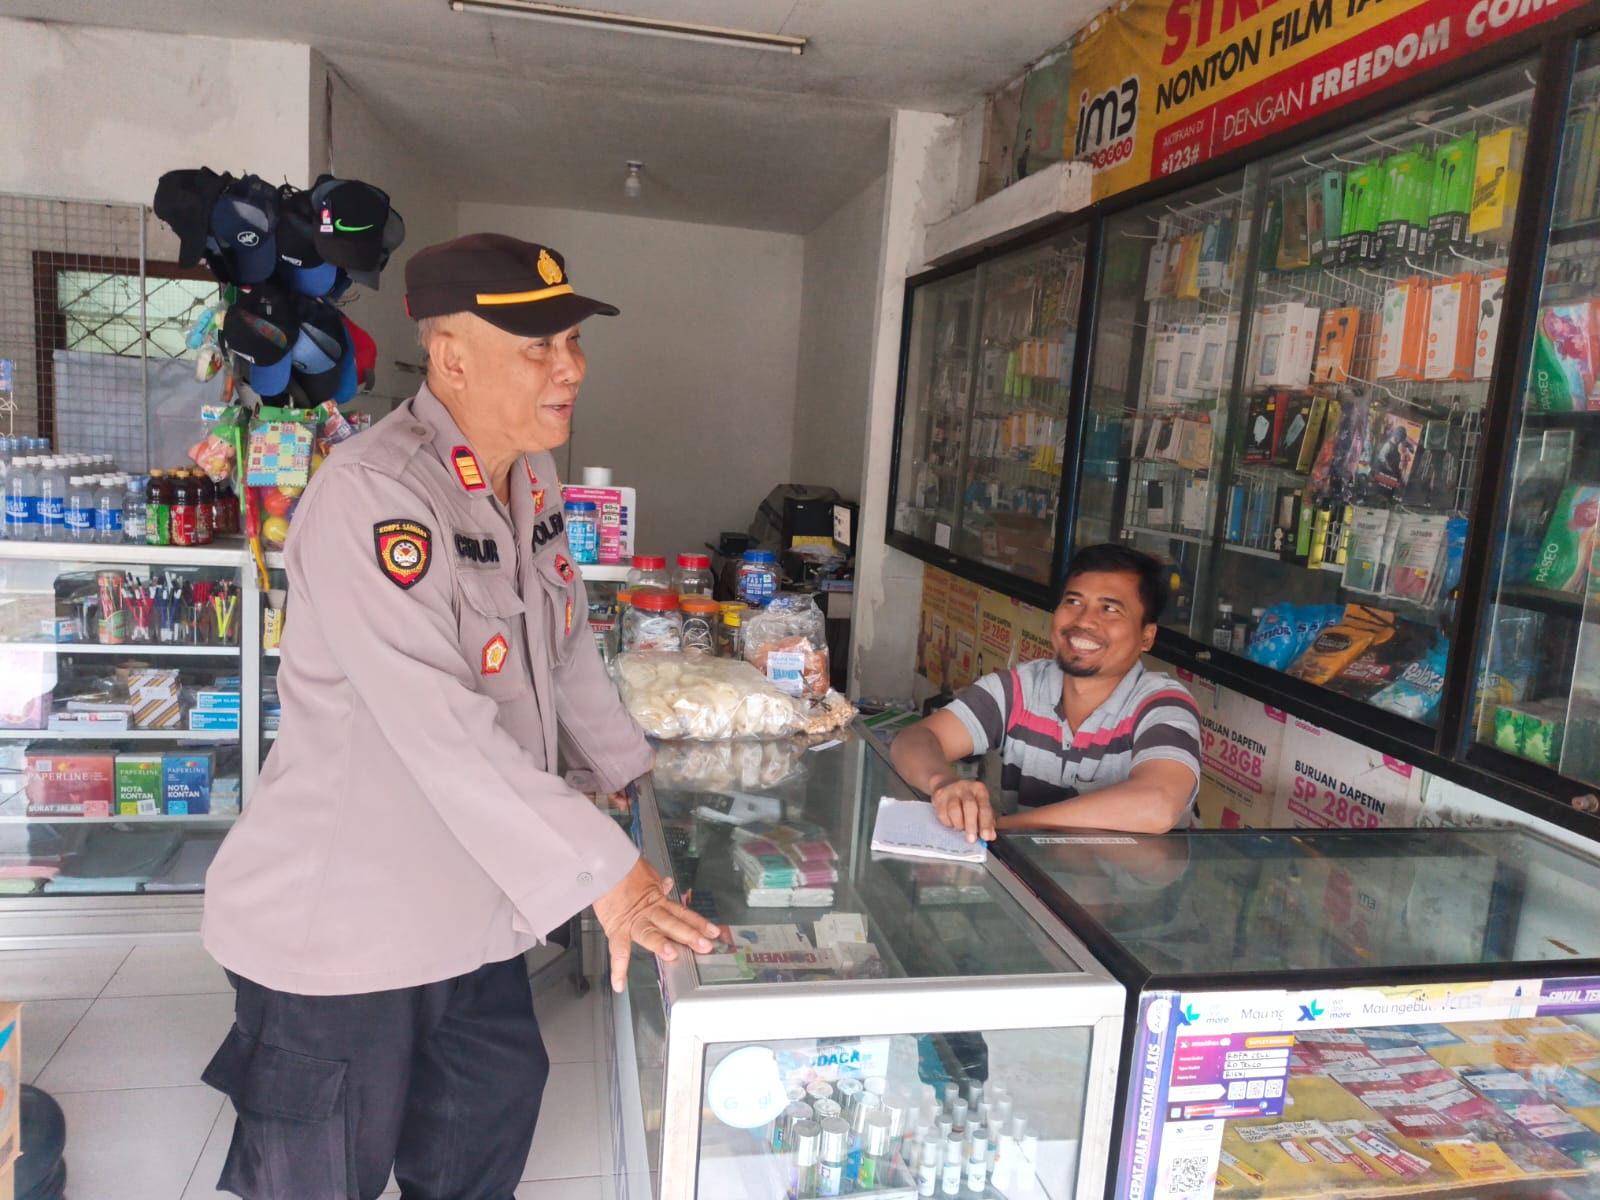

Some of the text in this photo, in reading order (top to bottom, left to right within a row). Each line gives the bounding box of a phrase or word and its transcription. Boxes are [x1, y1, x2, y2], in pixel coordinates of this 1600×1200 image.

[1156, 29, 1262, 115] NONTON
[1269, 0, 1333, 58] FILM
[1223, 82, 1305, 140] DENGAN
[1309, 16, 1450, 106] FREEDOM
[1535, 542, 1560, 583] PASEO
[1232, 730, 1267, 756] DAPETIN
[28, 772, 89, 781] PAPERLINE
[1293, 776, 1318, 804] SP
[1294, 760, 1338, 791] BURUAN
[1340, 781, 1386, 815] DAPETIN
[1296, 998, 1325, 1022] XL
[1146, 1043, 1161, 1073] AXIS
[1138, 1075, 1157, 1137] TERSTABIL
[1134, 1139, 1149, 1164] DAN
